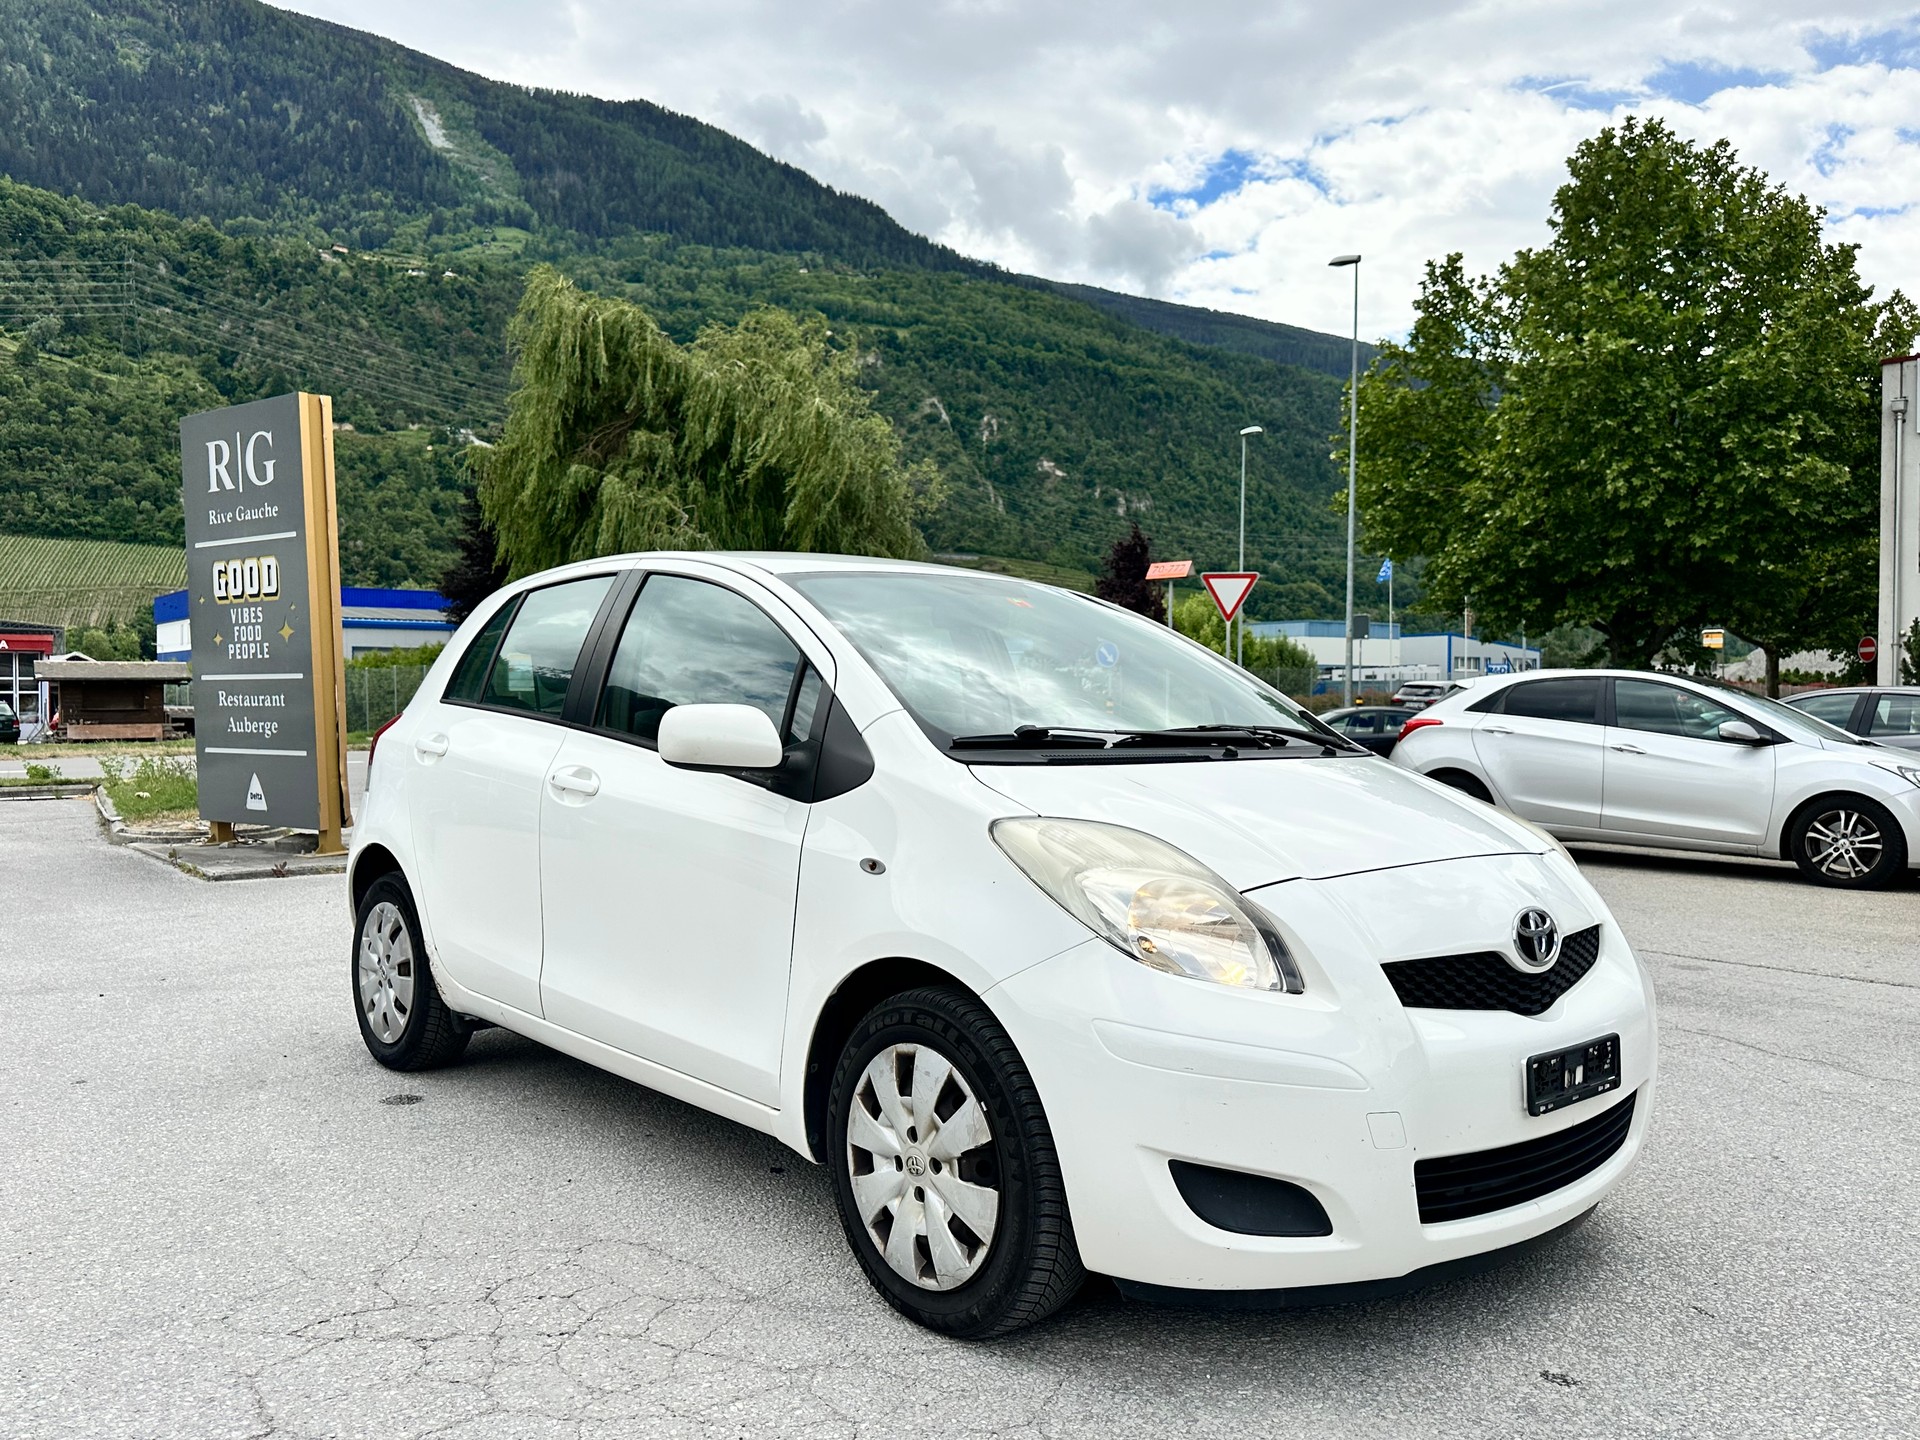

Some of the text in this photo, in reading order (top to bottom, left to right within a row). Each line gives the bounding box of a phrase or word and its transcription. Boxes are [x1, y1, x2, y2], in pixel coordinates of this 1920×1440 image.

[208, 502, 279, 525] Rive Gauche
[213, 555, 280, 605] GOOD
[230, 606, 263, 625] VIBES
[233, 625, 263, 642] FOOD
[228, 642, 270, 660] PEOPLE
[218, 690, 286, 707] Restaurant
[227, 717, 279, 739] Auberge
[250, 792, 263, 801] Delta
